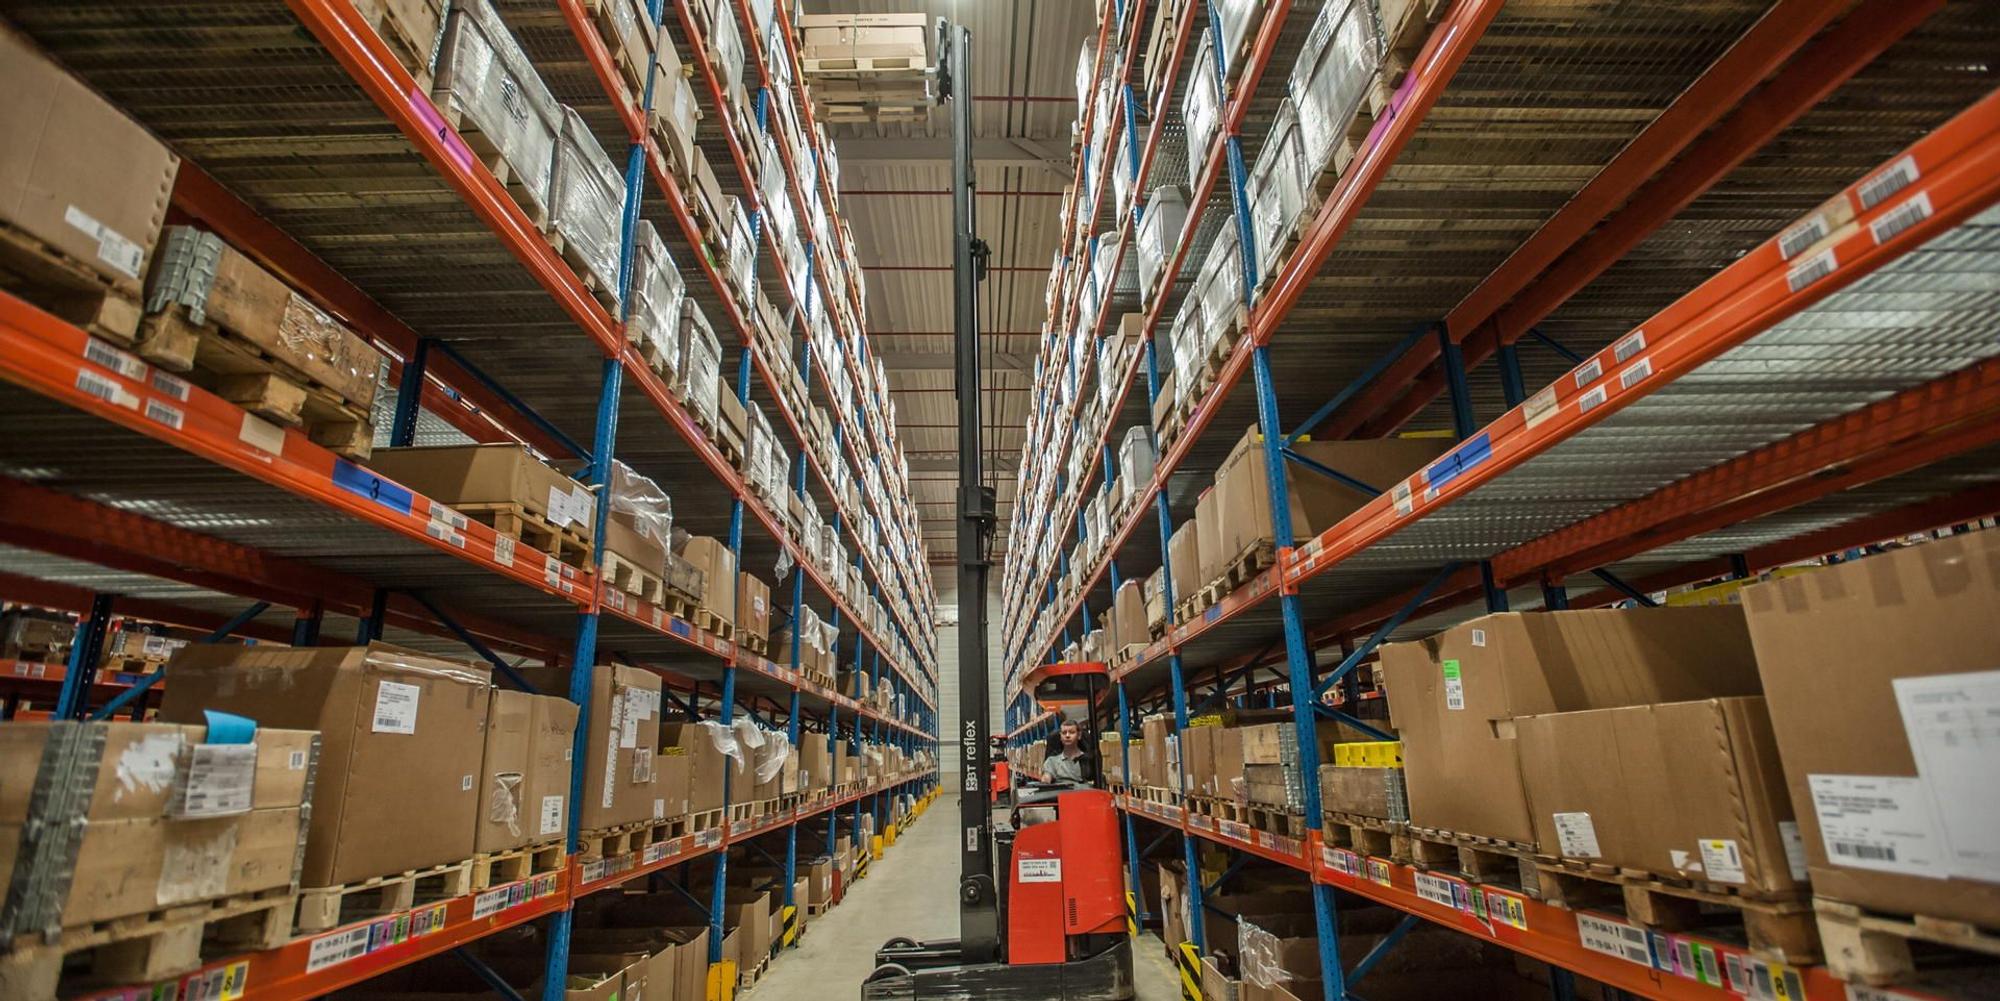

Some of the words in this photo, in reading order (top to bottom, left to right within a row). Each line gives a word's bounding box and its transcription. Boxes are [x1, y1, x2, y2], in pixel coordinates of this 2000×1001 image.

[438, 126, 447, 144] 4
[369, 478, 380, 500] 3
[964, 720, 977, 760] reflex
[966, 764, 977, 779] BT
[224, 975, 233, 992] 8
[1648, 969, 1662, 990] 4
[1745, 967, 1754, 987] 7
[1774, 976, 1786, 997] 8
